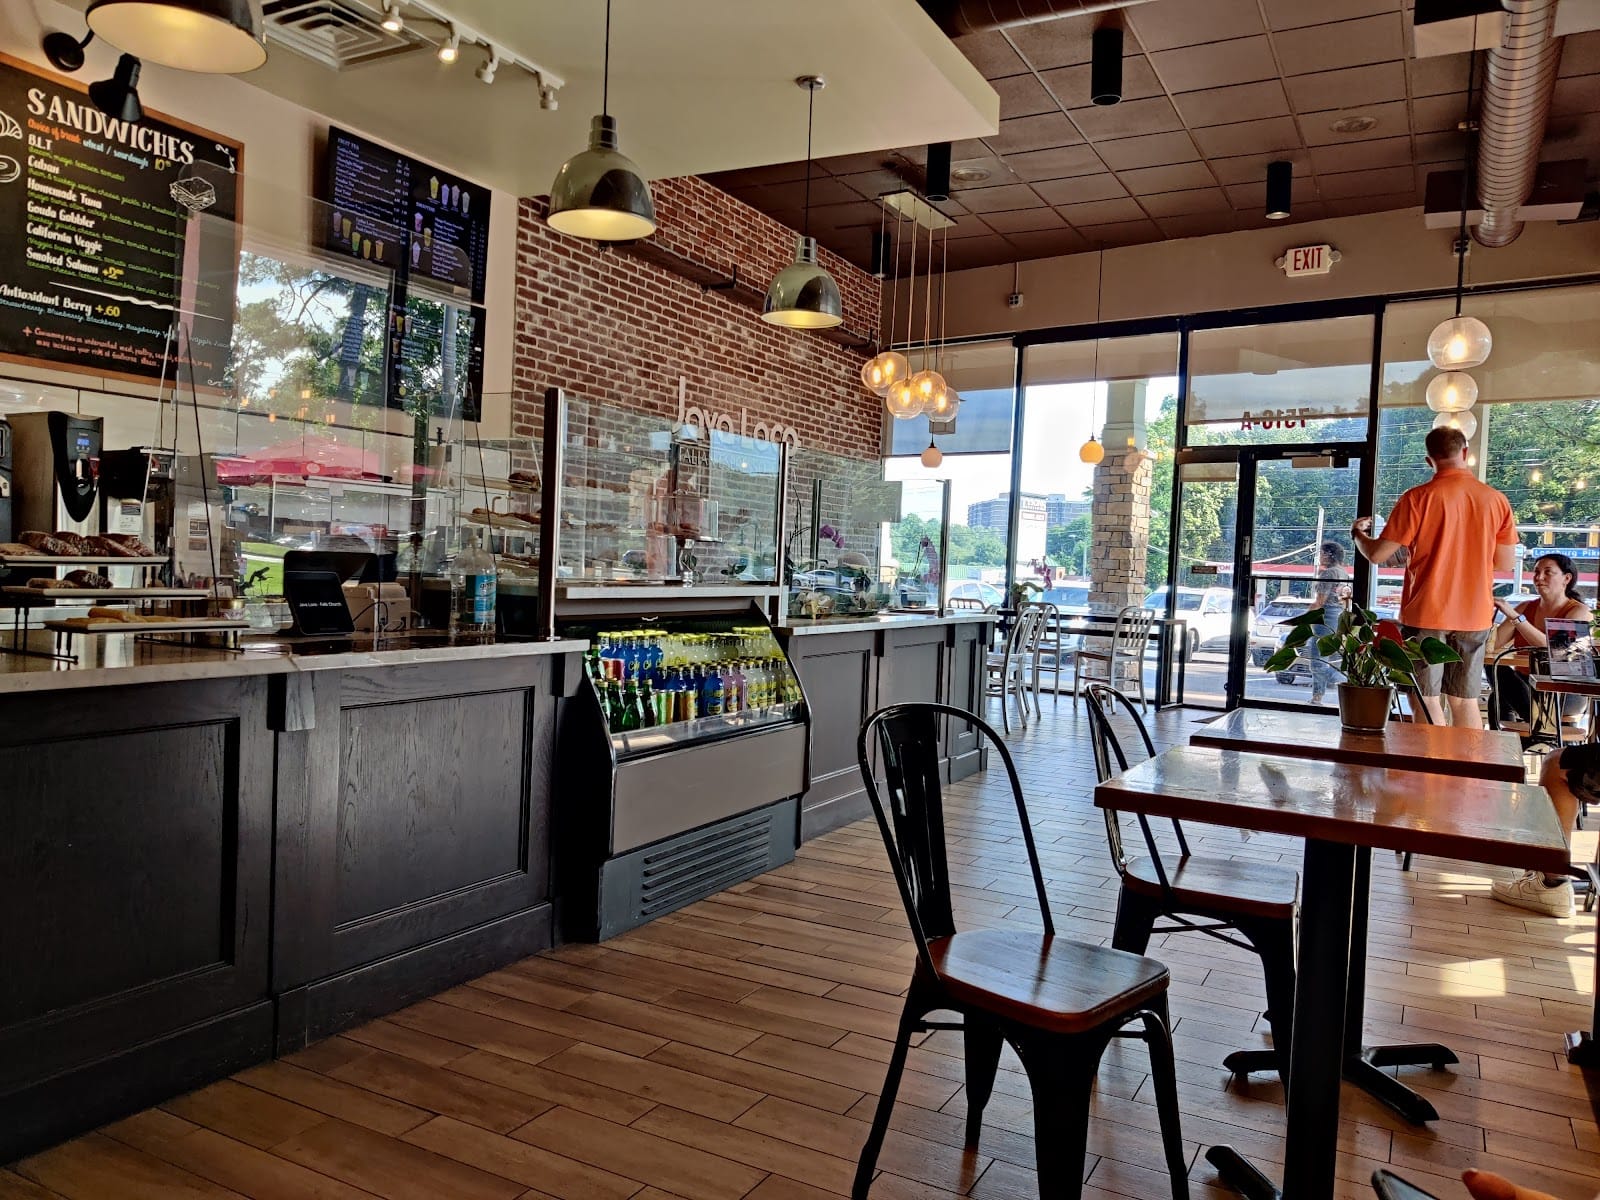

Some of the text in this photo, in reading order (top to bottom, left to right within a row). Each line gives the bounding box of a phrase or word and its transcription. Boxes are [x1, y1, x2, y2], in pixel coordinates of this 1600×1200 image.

[27, 88, 195, 164] SANDWICHES
[28, 155, 59, 174] Cuban
[27, 178, 102, 209] Homemade Tuna
[27, 200, 95, 229] Gouda Gobbler
[26, 222, 103, 253] California Veggie
[26, 247, 63, 267] Smoked
[66, 256, 99, 274] Salmon
[1294, 248, 1323, 270] EXIT
[0, 284, 59, 306] Antioxidant
[63, 298, 93, 316] Berry
